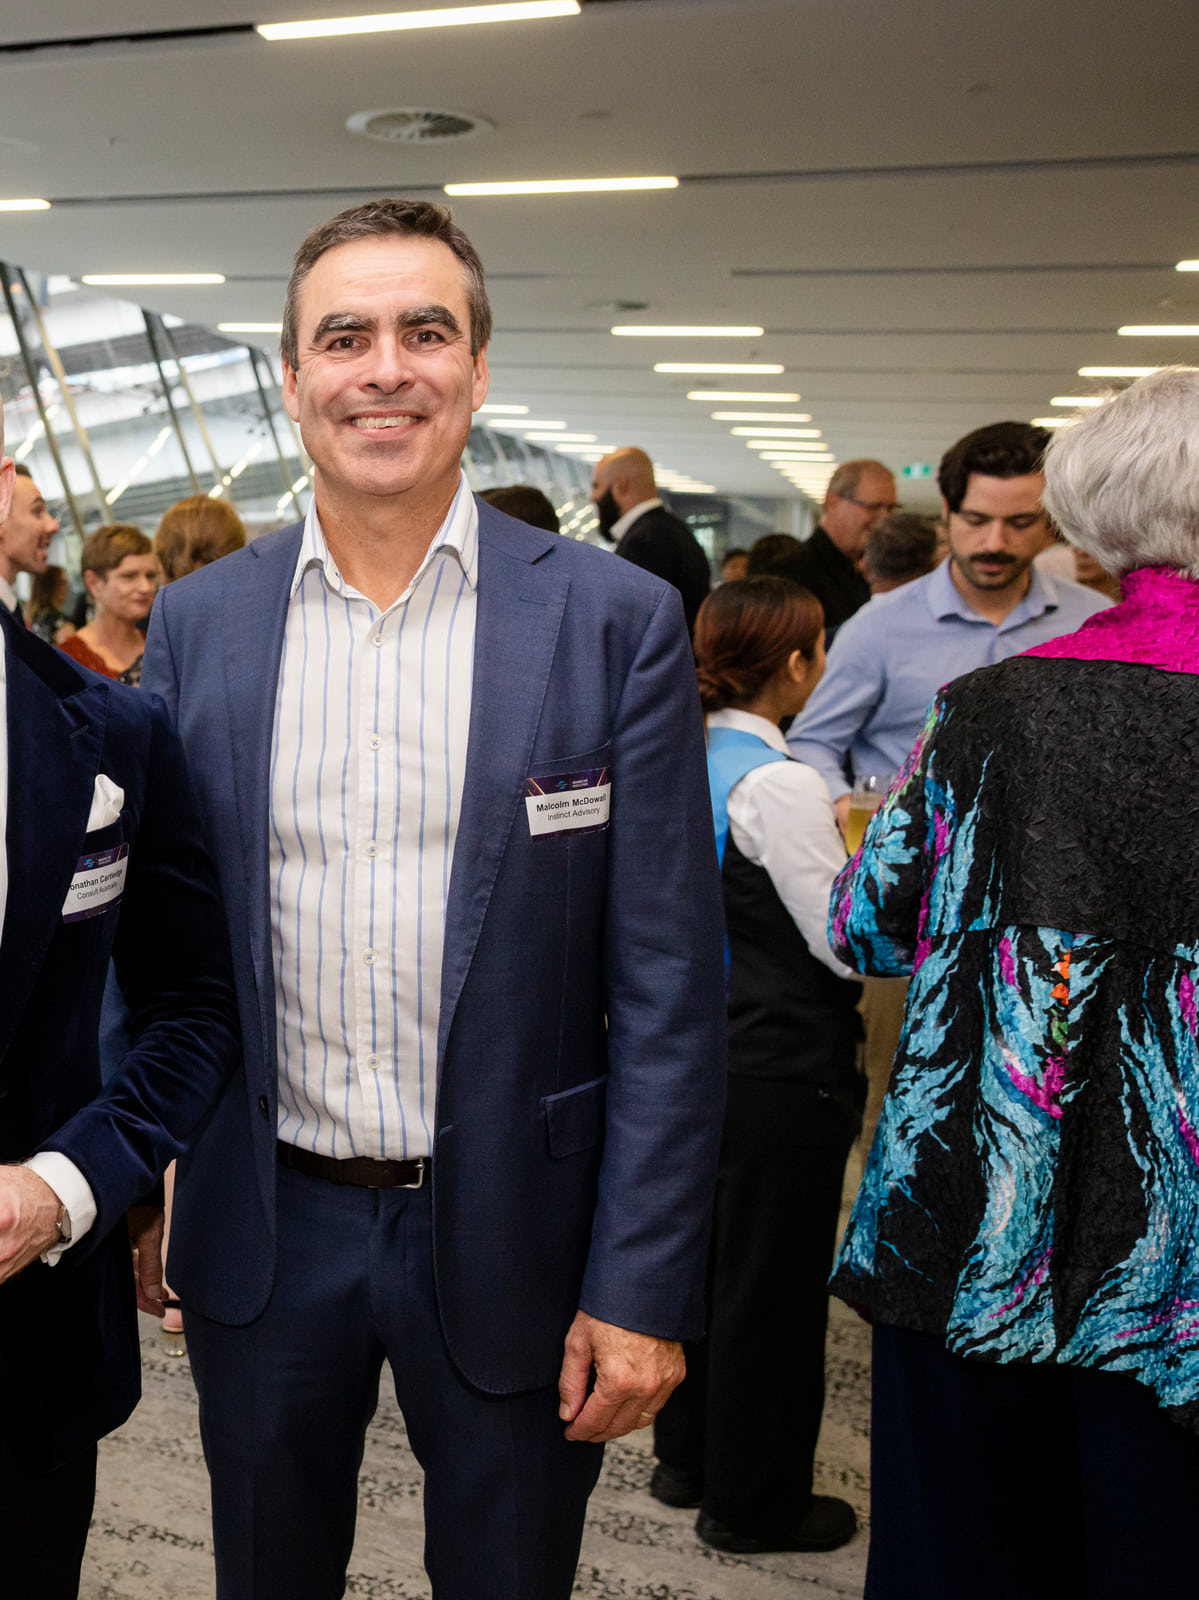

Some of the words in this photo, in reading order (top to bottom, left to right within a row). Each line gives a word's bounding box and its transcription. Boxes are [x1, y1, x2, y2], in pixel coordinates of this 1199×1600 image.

[536, 800, 570, 812] Malcolm
[572, 793, 607, 807] McDowall
[548, 811, 571, 821] Instinct
[572, 807, 601, 818] Advisory
[69, 878, 99, 891] onathan
[76, 888, 99, 900] Consult
